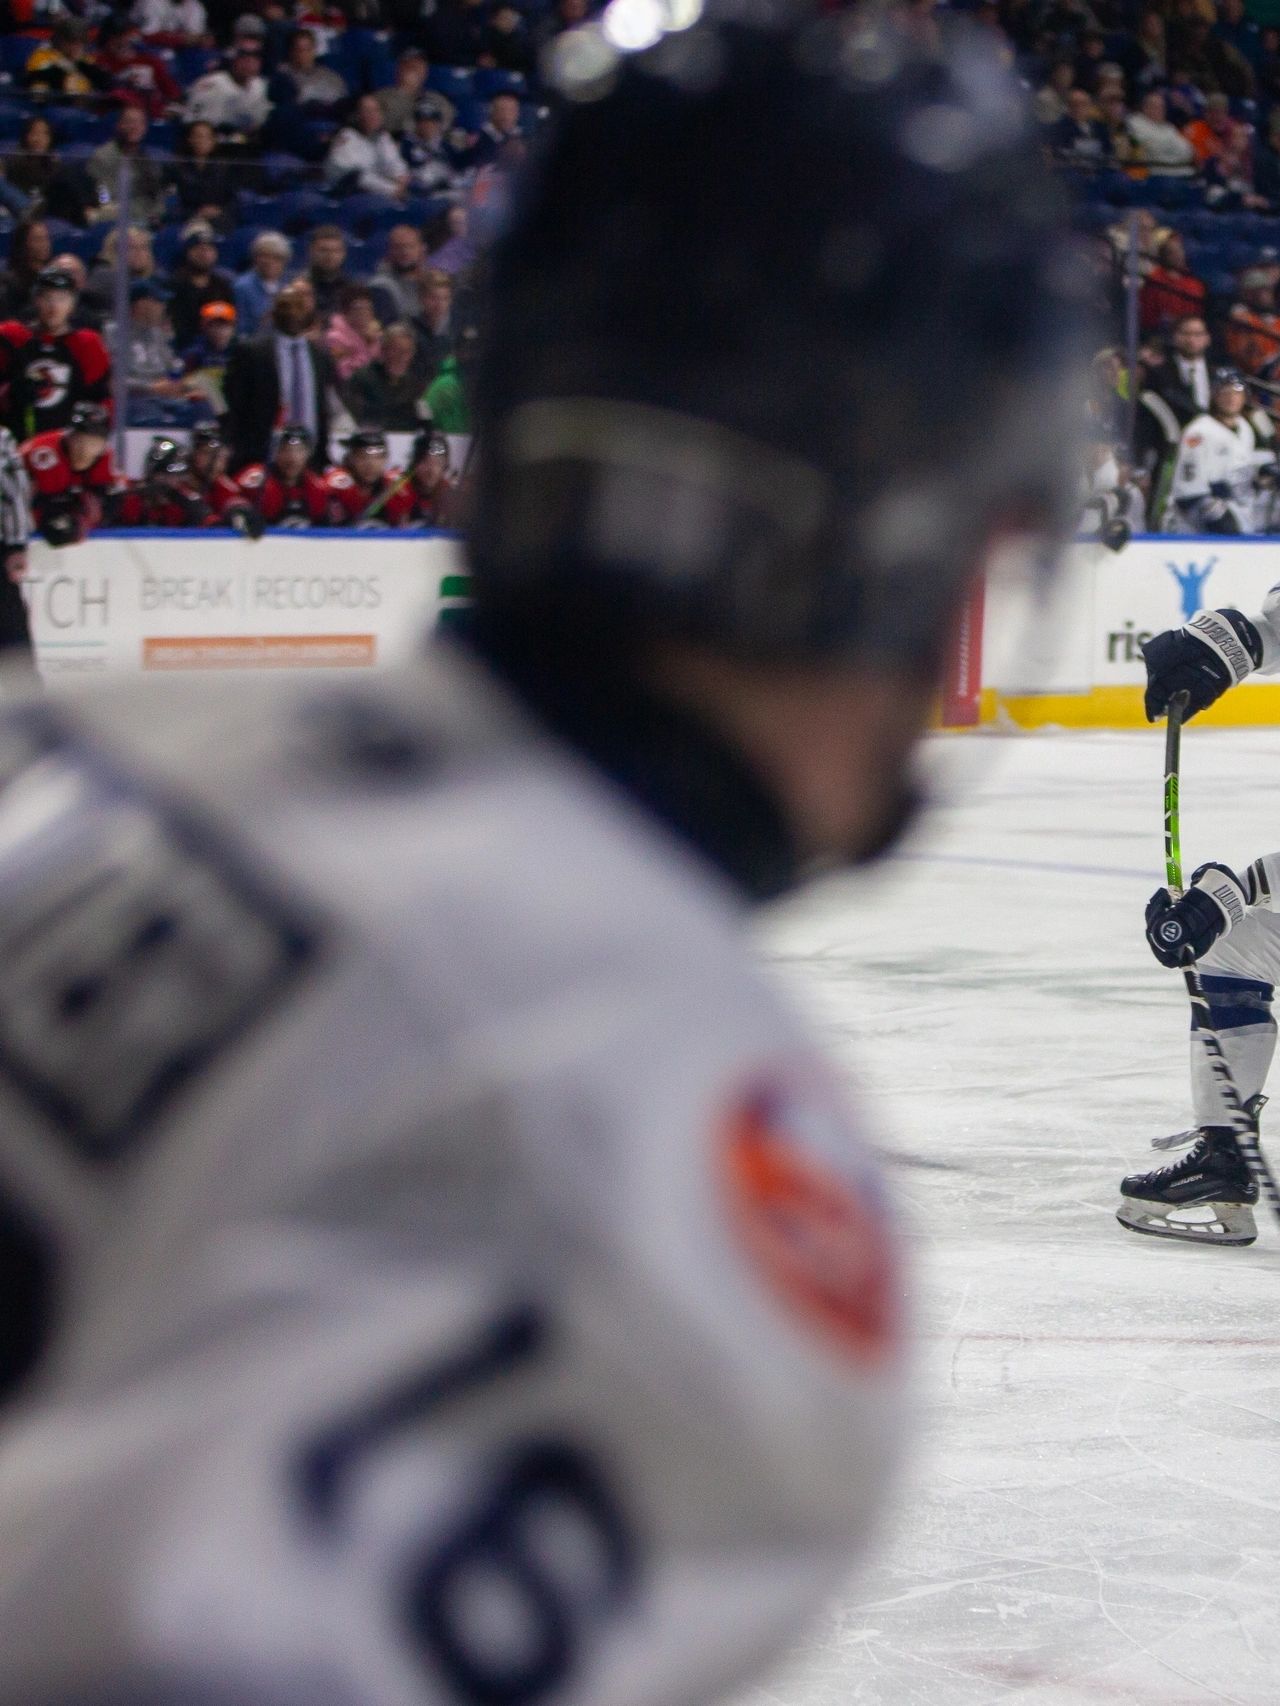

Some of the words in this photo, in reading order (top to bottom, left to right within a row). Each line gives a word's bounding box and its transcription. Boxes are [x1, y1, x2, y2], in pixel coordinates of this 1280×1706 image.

[20, 578, 109, 628] TCH
[141, 576, 232, 611] BREAK
[255, 576, 381, 610] RECORDS
[1188, 615, 1250, 681] WARRIO
